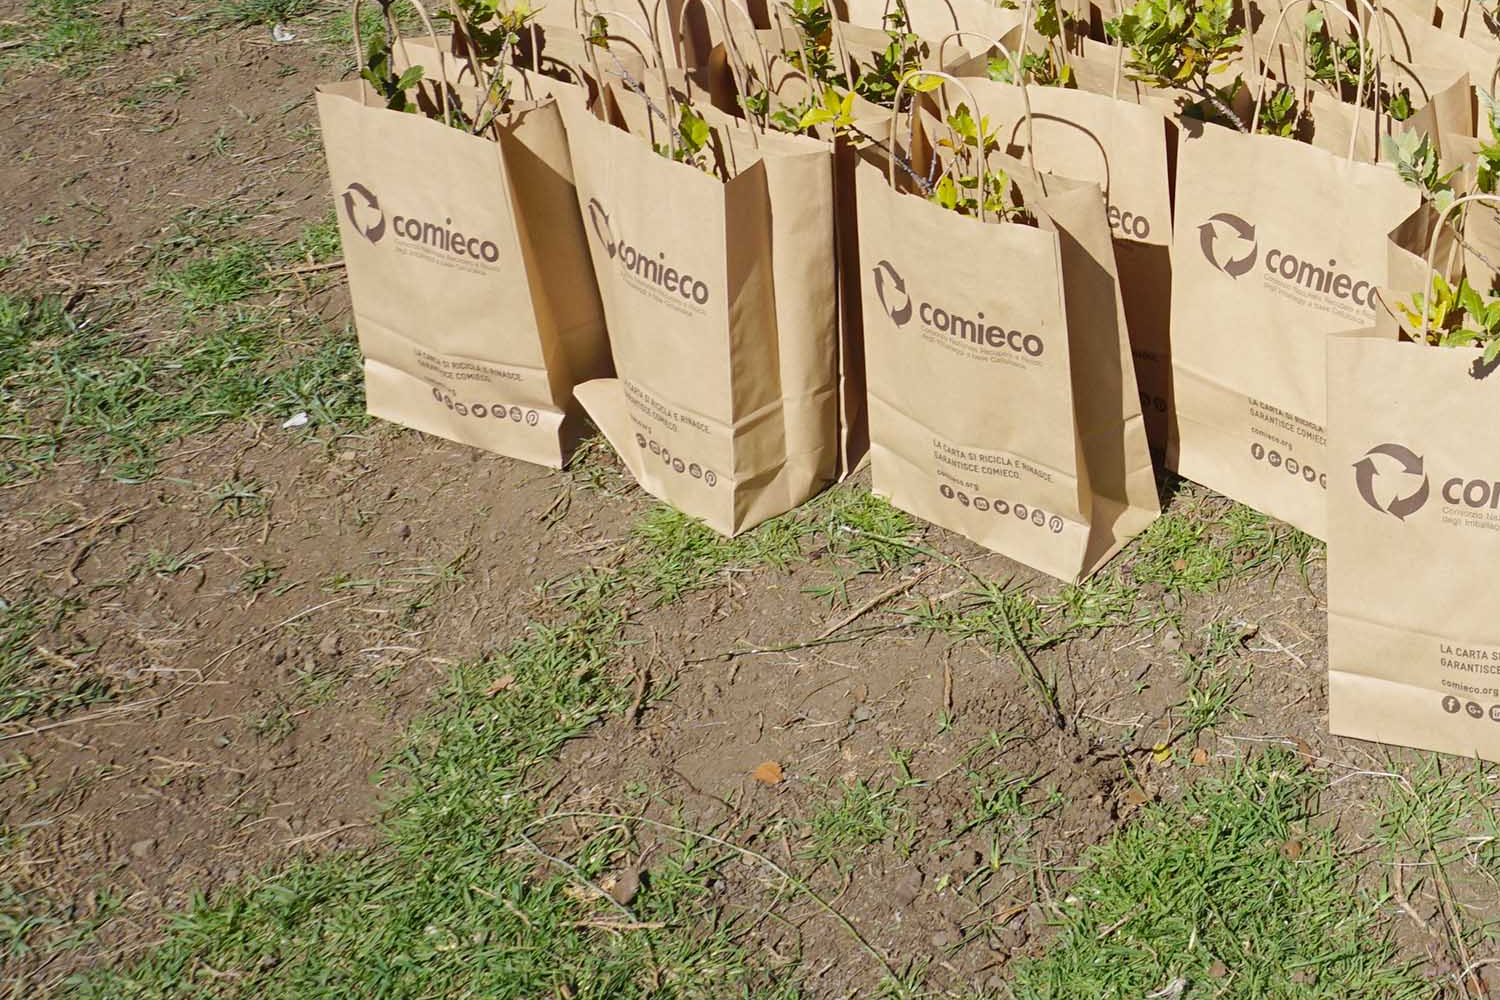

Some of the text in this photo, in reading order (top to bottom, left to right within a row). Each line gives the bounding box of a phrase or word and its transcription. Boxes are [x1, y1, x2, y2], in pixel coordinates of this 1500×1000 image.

[393, 215, 500, 263] comieco
[618, 239, 709, 305] comieco
[919, 302, 1044, 357] comieco
[968, 452, 977, 461] SI
[979, 454, 1013, 467] RICICLA
[1440, 644, 1453, 655] LA
[1455, 647, 1488, 661] CARTA
[1441, 679, 1499, 697] comieco.org
